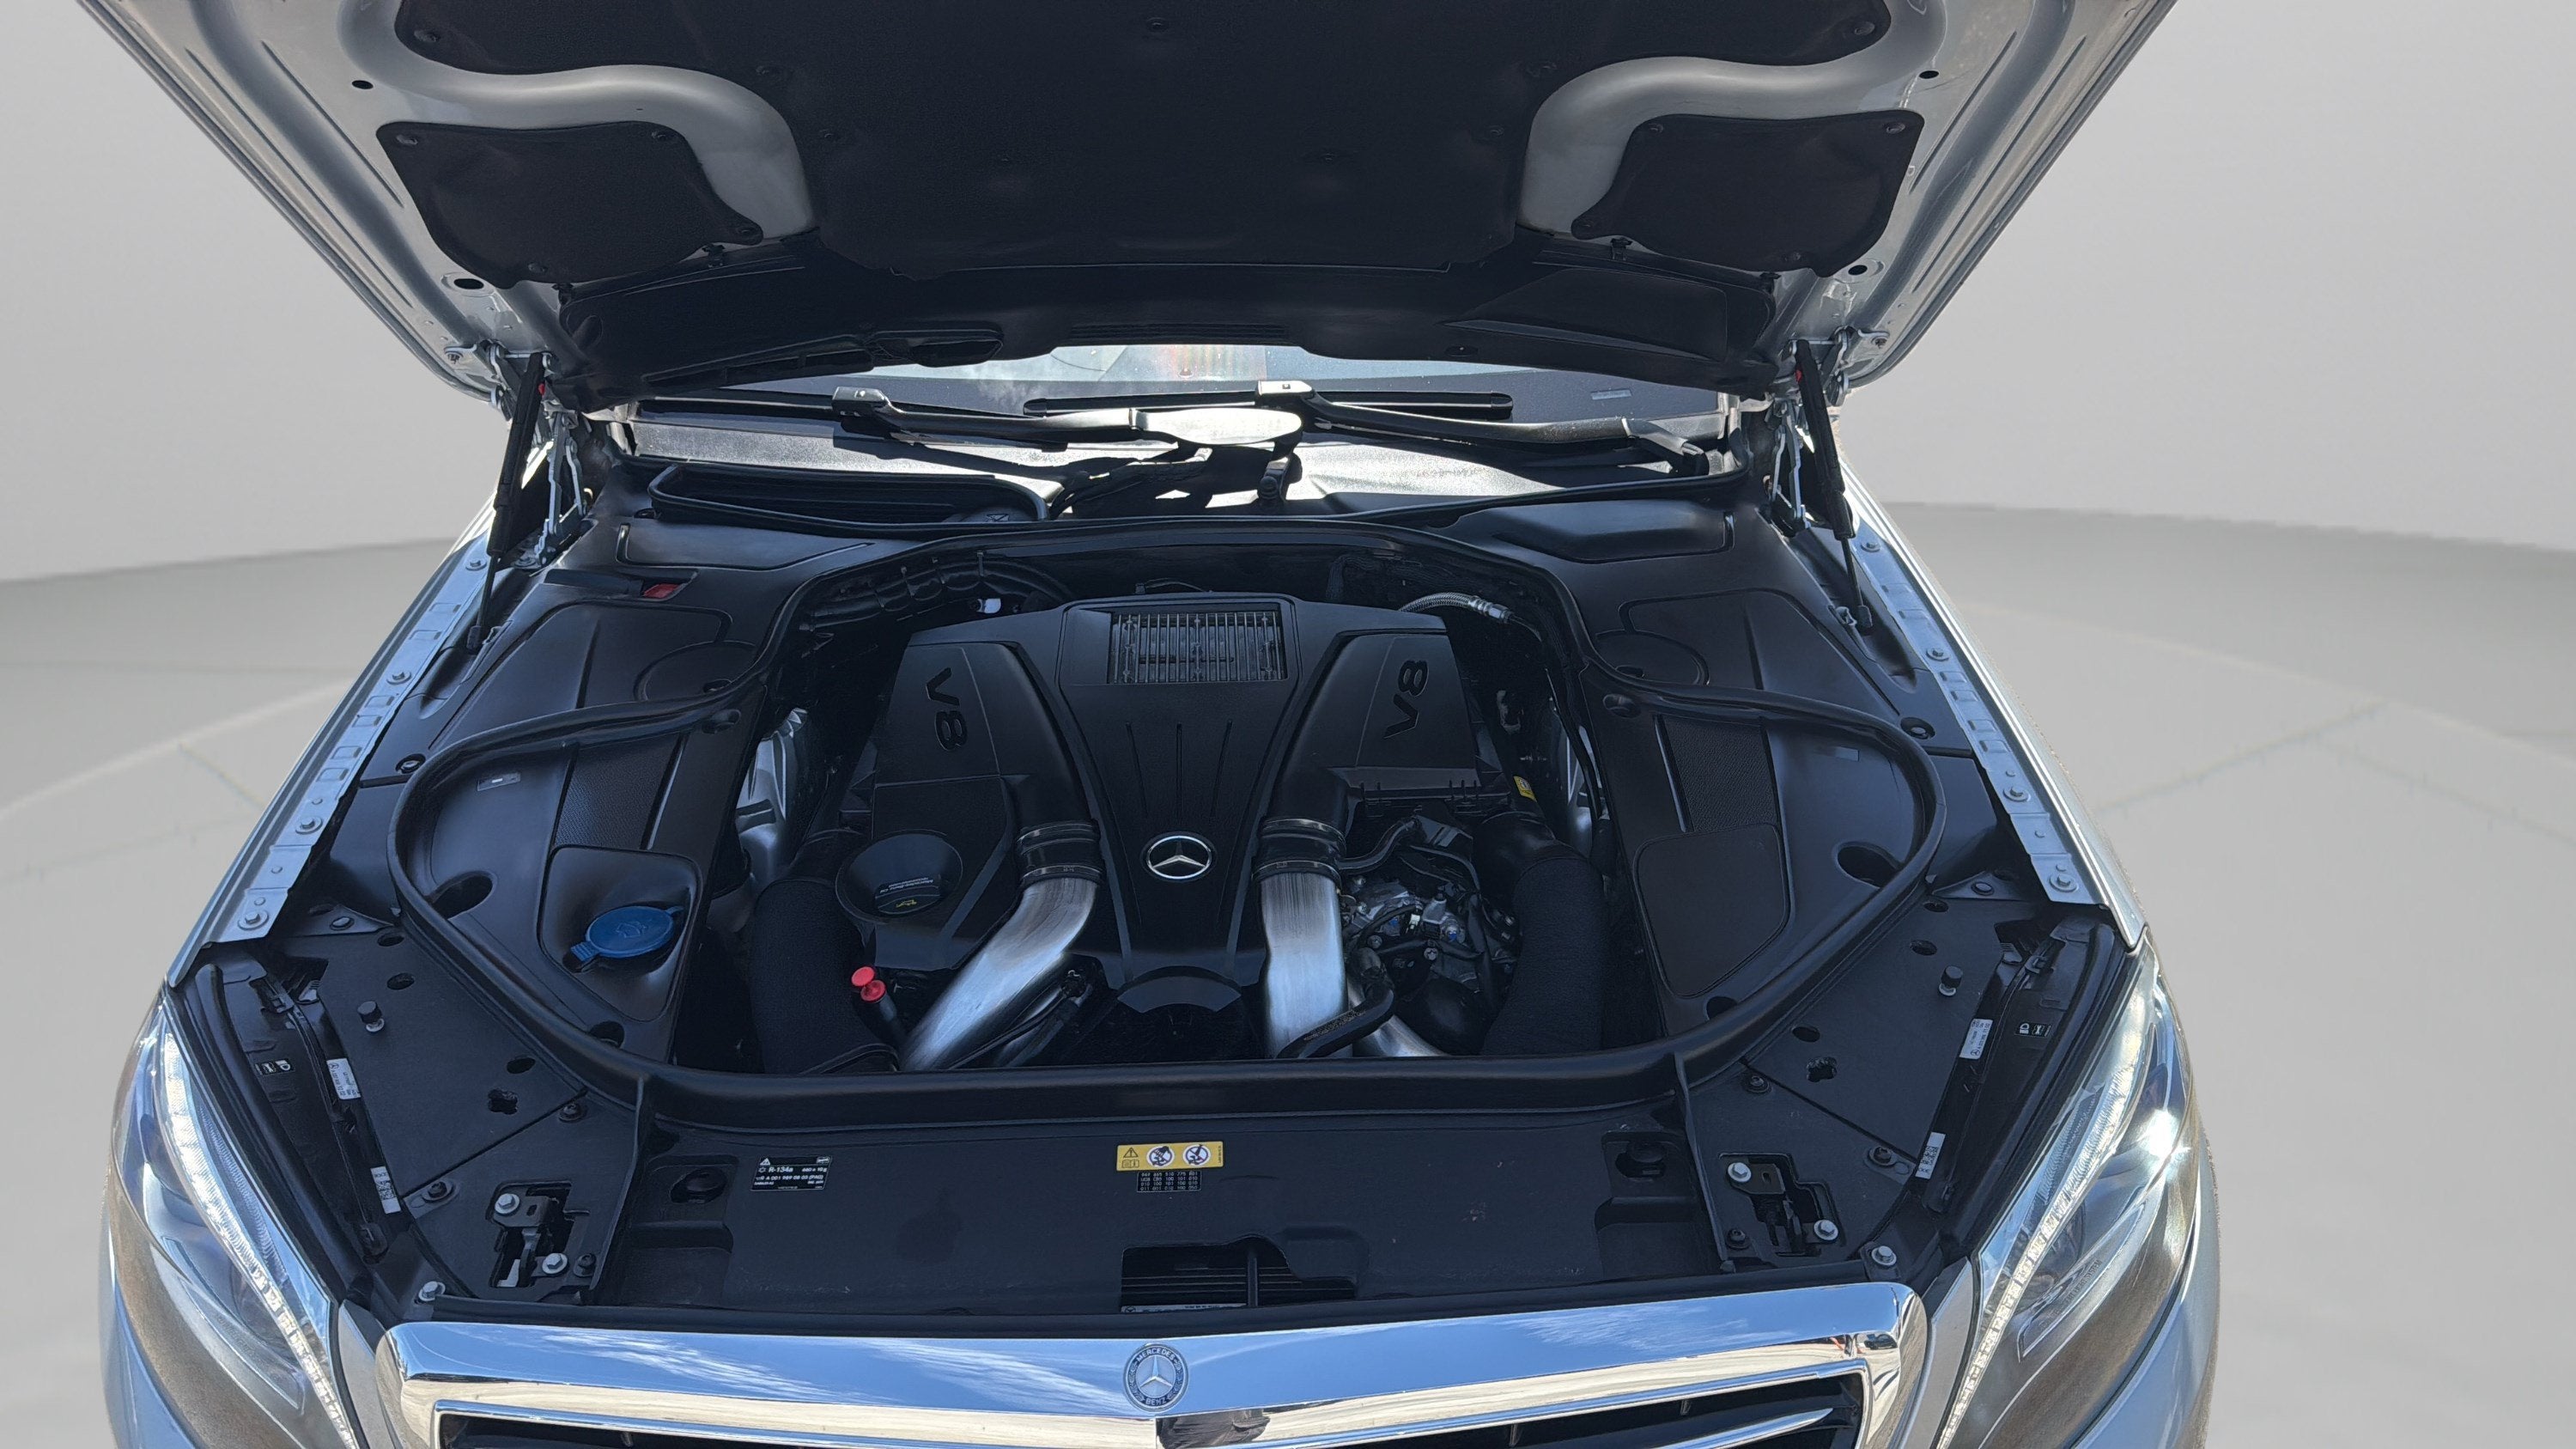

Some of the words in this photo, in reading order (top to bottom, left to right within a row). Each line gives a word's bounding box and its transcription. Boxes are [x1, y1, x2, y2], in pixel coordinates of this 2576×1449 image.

[927, 667, 967, 750] V8
[1382, 660, 1429, 739] V8
[1137, 1348, 1176, 1362] MERCEDES
[1145, 1397, 1167, 1406] BENZ
